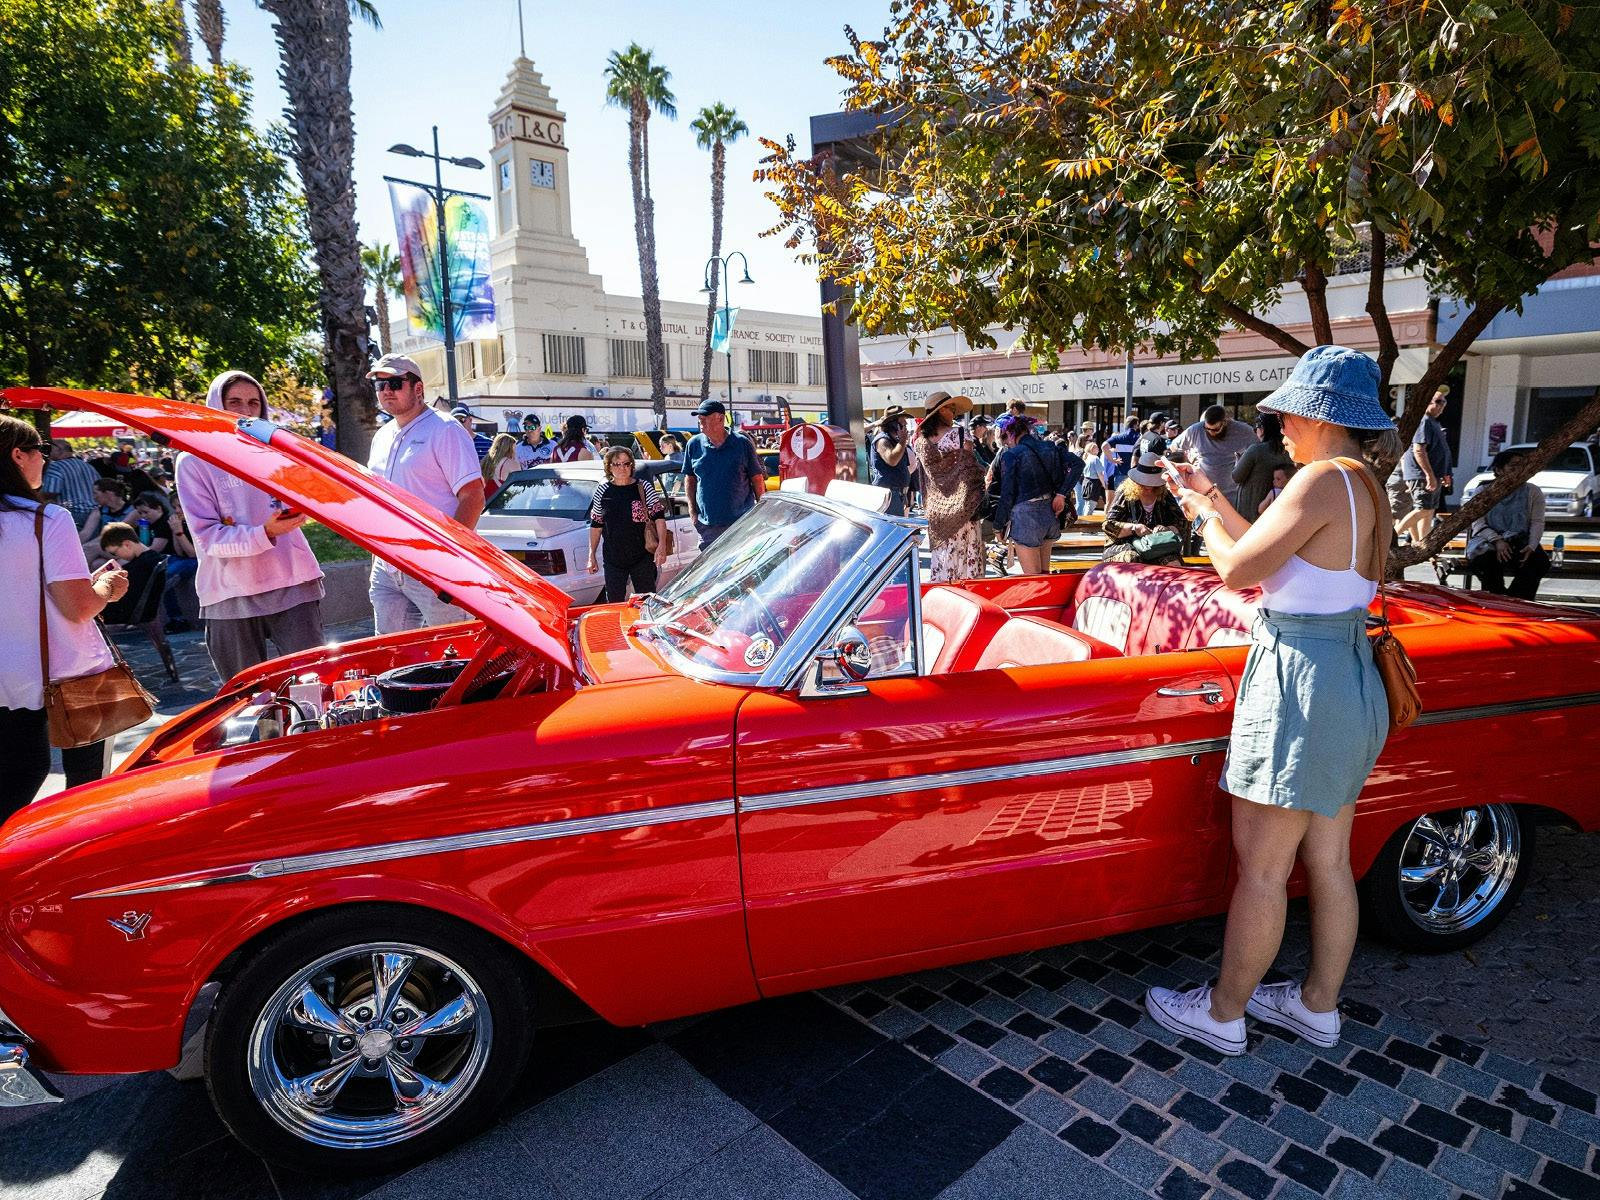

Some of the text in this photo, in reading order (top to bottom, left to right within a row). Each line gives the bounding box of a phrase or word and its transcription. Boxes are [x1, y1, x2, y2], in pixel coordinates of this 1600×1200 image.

[621, 319, 627, 329] T
[630, 321, 636, 330] &
[695, 326, 708, 336] LIF
[765, 333, 795, 344] SOCIETY
[800, 335, 824, 346] LIMITE
[903, 367, 1294, 401] STEAK PIZZA PIDE PASTA FUNCTIONS & CATE
[672, 399, 700, 408] BUILDIN
